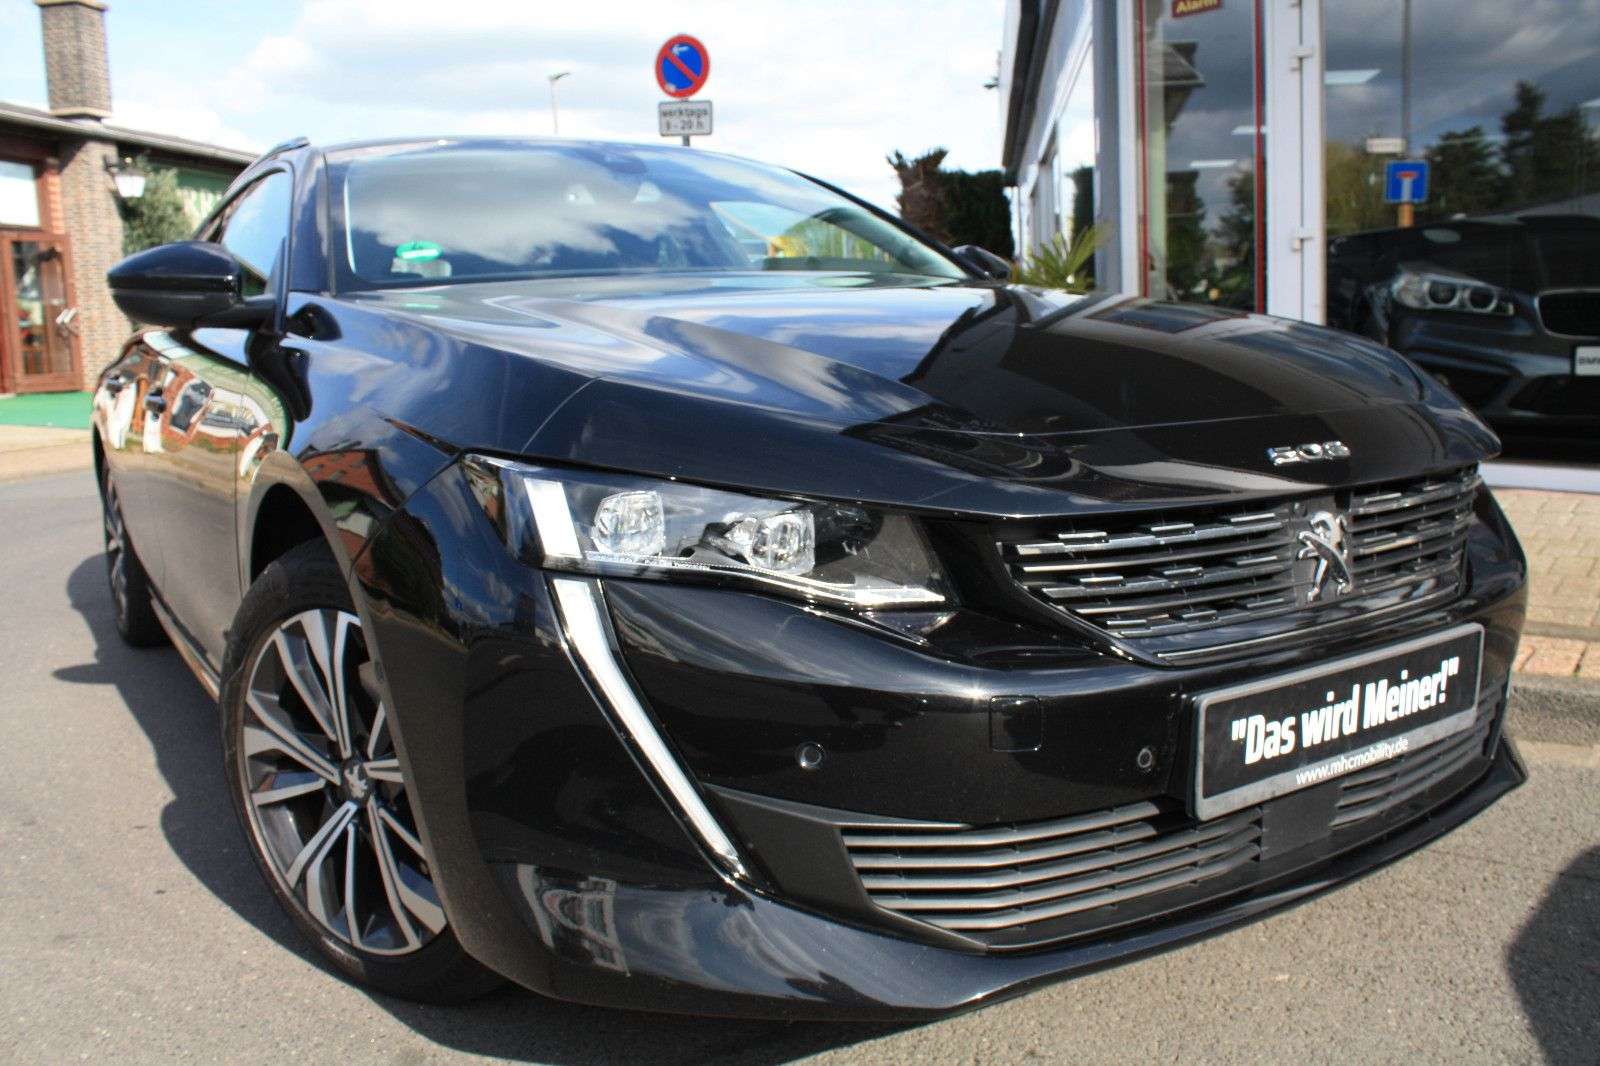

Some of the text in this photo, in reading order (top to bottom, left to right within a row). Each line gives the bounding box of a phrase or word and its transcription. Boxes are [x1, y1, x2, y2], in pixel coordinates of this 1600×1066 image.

[1231, 656, 1460, 765] "Das wird Meiner!"
[1296, 737, 1409, 785] www.mhcmobility.de
